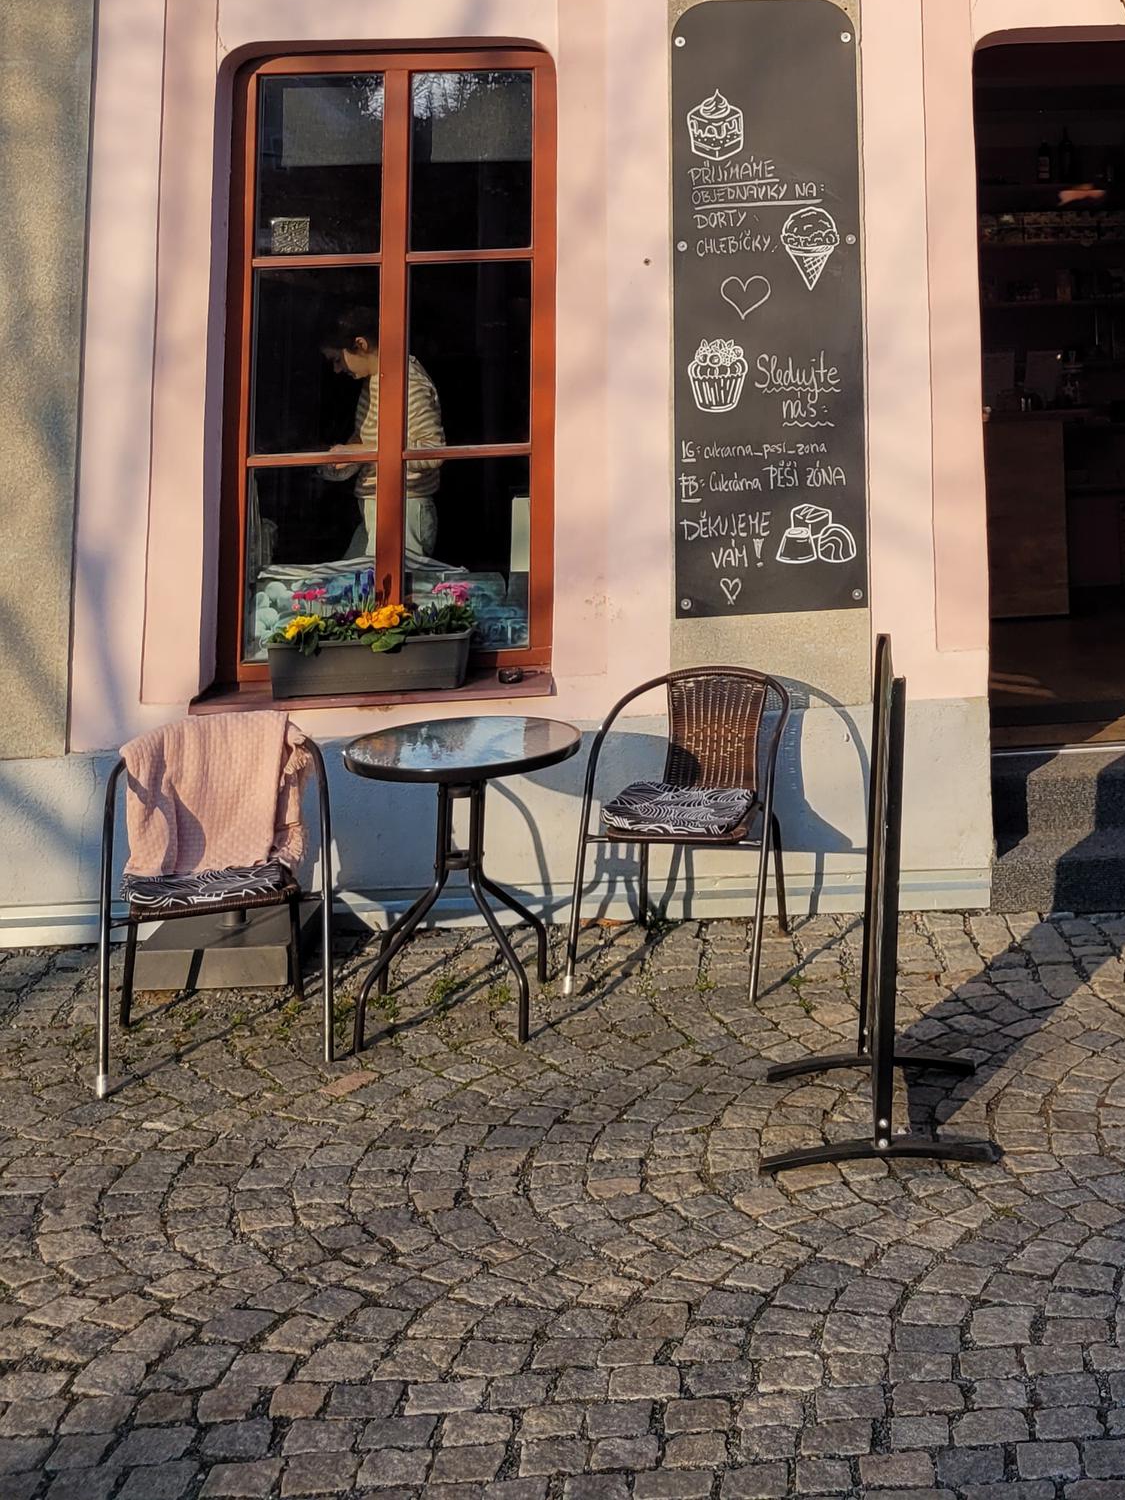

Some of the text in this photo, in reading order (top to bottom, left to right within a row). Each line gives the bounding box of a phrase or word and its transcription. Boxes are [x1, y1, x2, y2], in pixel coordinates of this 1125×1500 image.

[687, 155, 775, 186] PŘIJÍMÁME
[754, 350, 841, 404] Sledujte
[806, 460, 847, 487] ZÓNA
[680, 510, 772, 541] DĚKUJEME
